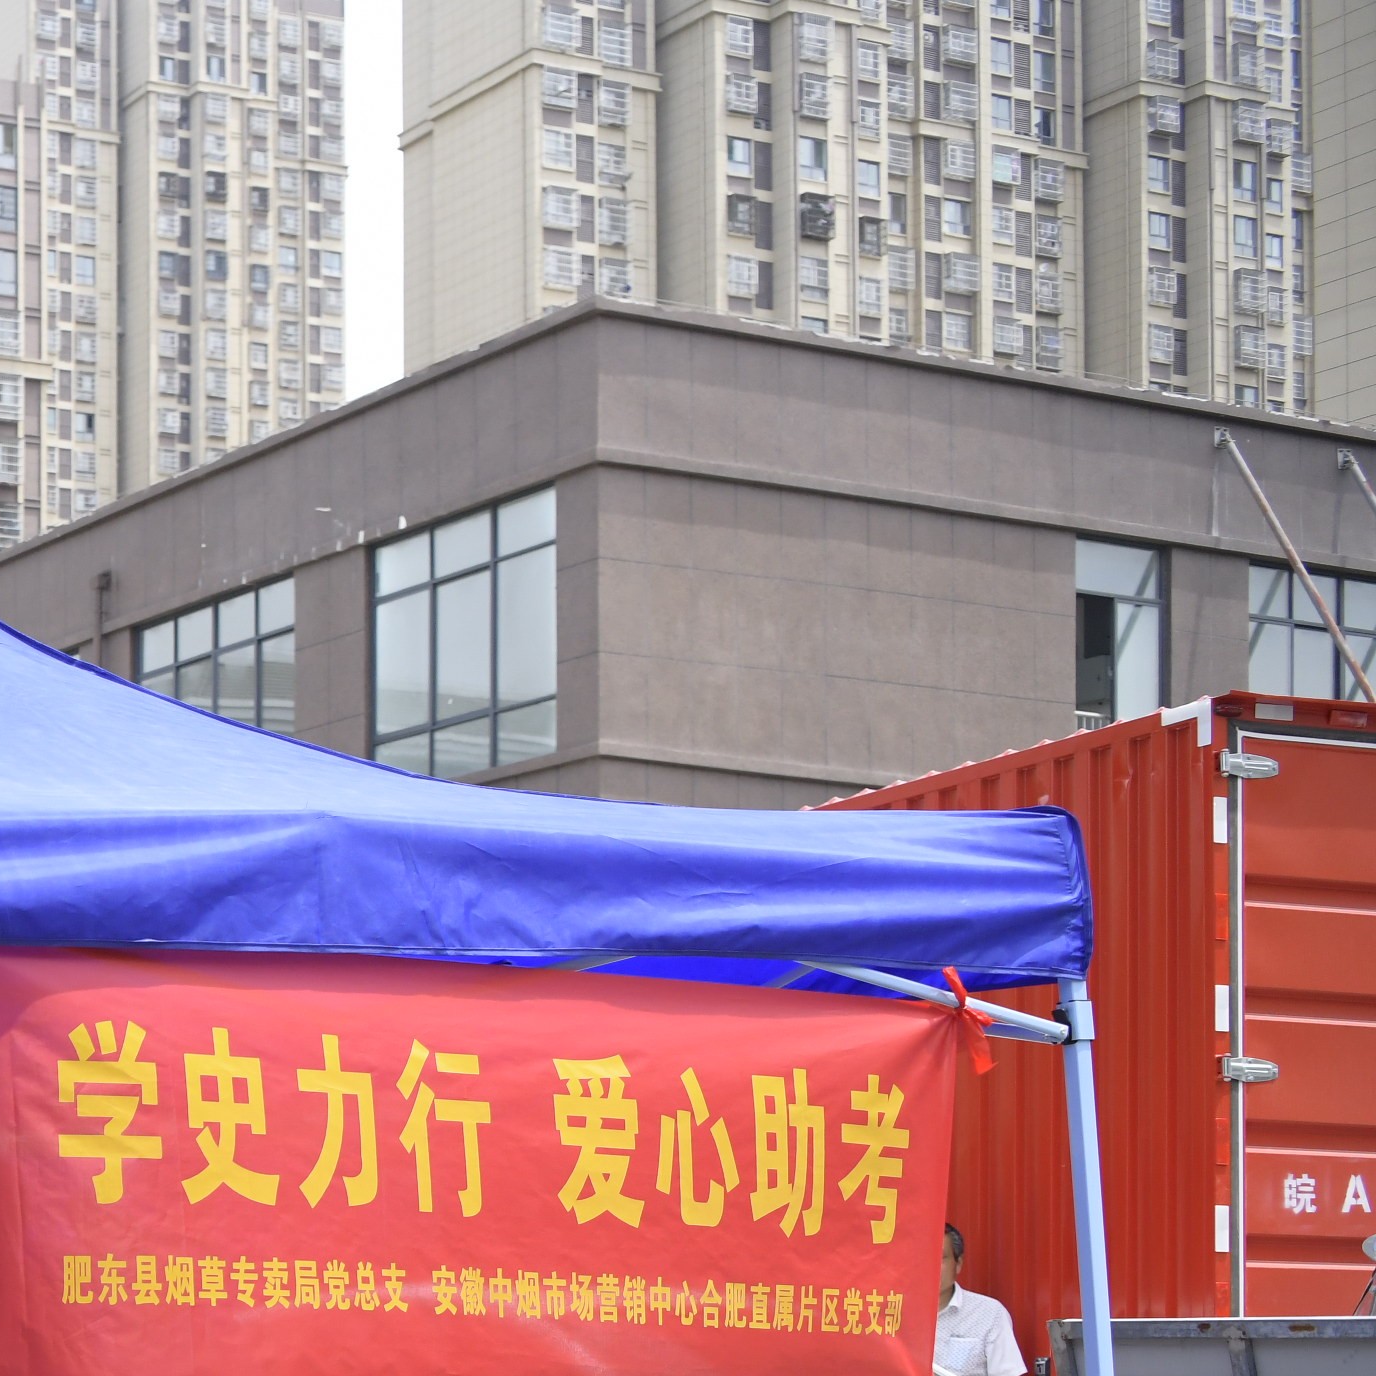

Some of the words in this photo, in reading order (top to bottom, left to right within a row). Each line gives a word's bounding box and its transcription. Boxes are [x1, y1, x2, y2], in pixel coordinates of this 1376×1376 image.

[56, 1020, 492, 1218] 学史力行
[552, 1054, 911, 1246] 爱心助考
[62, 1253, 409, 1313] 肥东县烟草专卖局党总支
[431, 1264, 904, 1338] 安徽中烟市场营销中心合肥直属片区党支部
